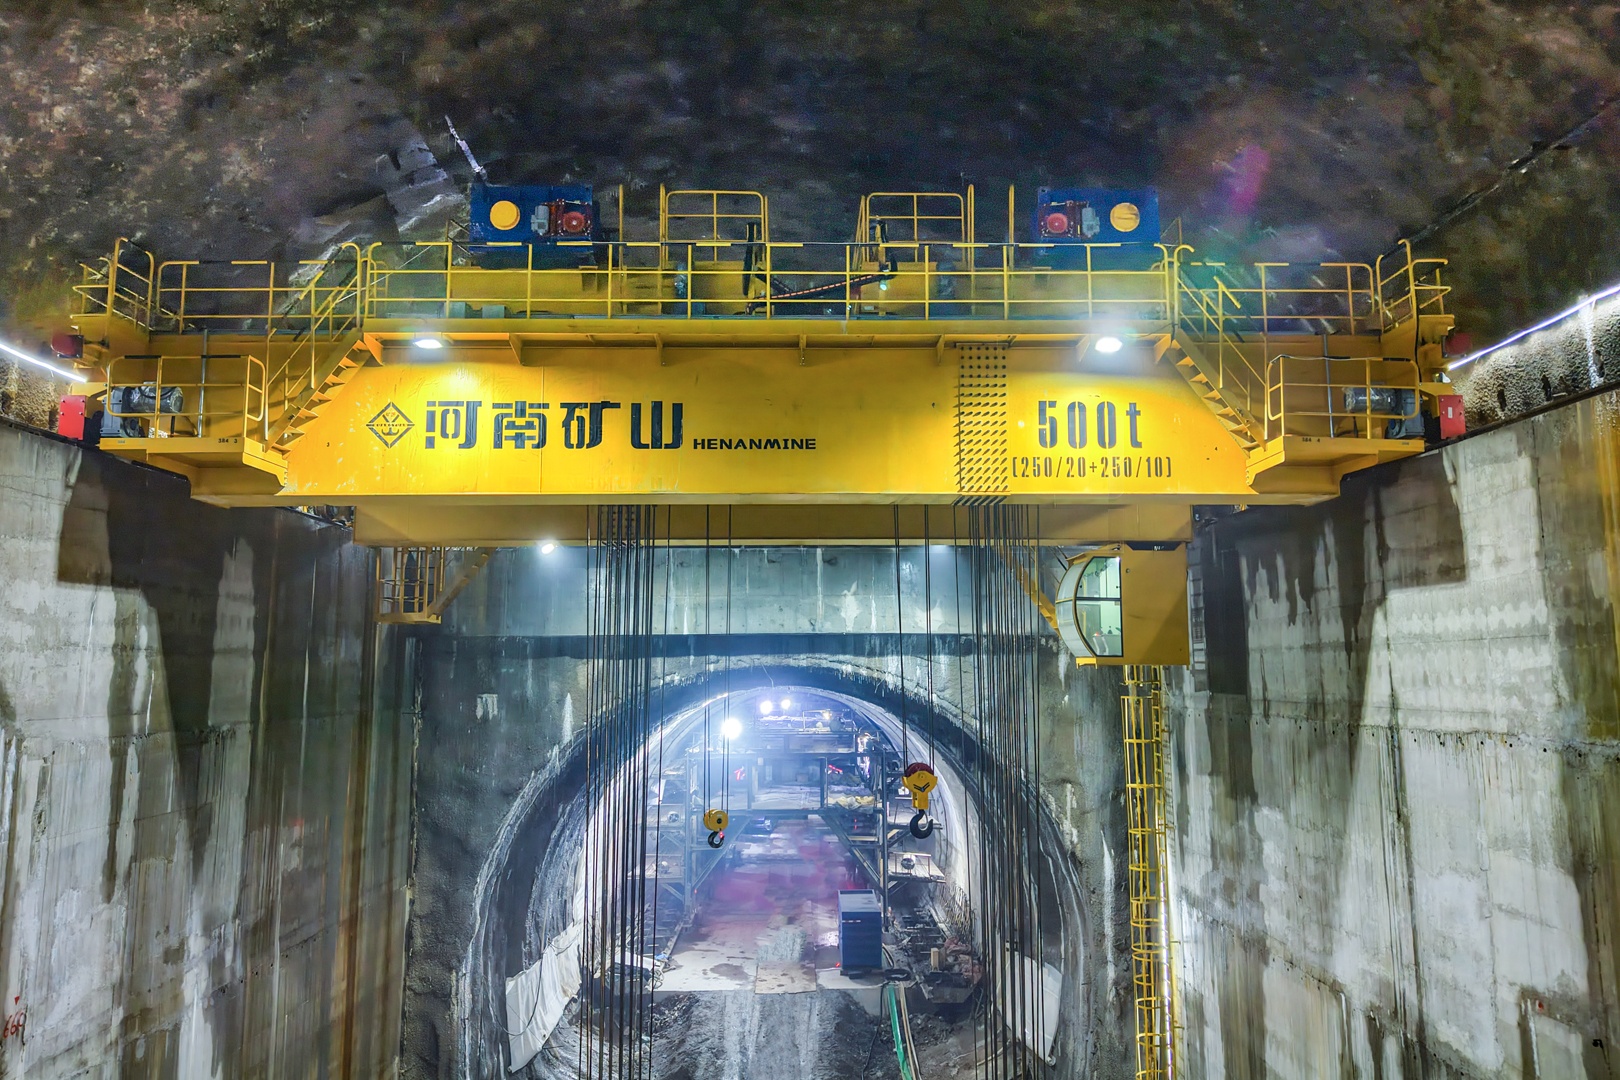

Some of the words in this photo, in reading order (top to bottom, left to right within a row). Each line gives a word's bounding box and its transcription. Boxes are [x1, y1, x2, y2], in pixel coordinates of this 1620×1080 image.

[425, 400, 684, 450] 河南矿山
[693, 438, 816, 450] HENANMINE
[1038, 400, 1142, 449] 500t
